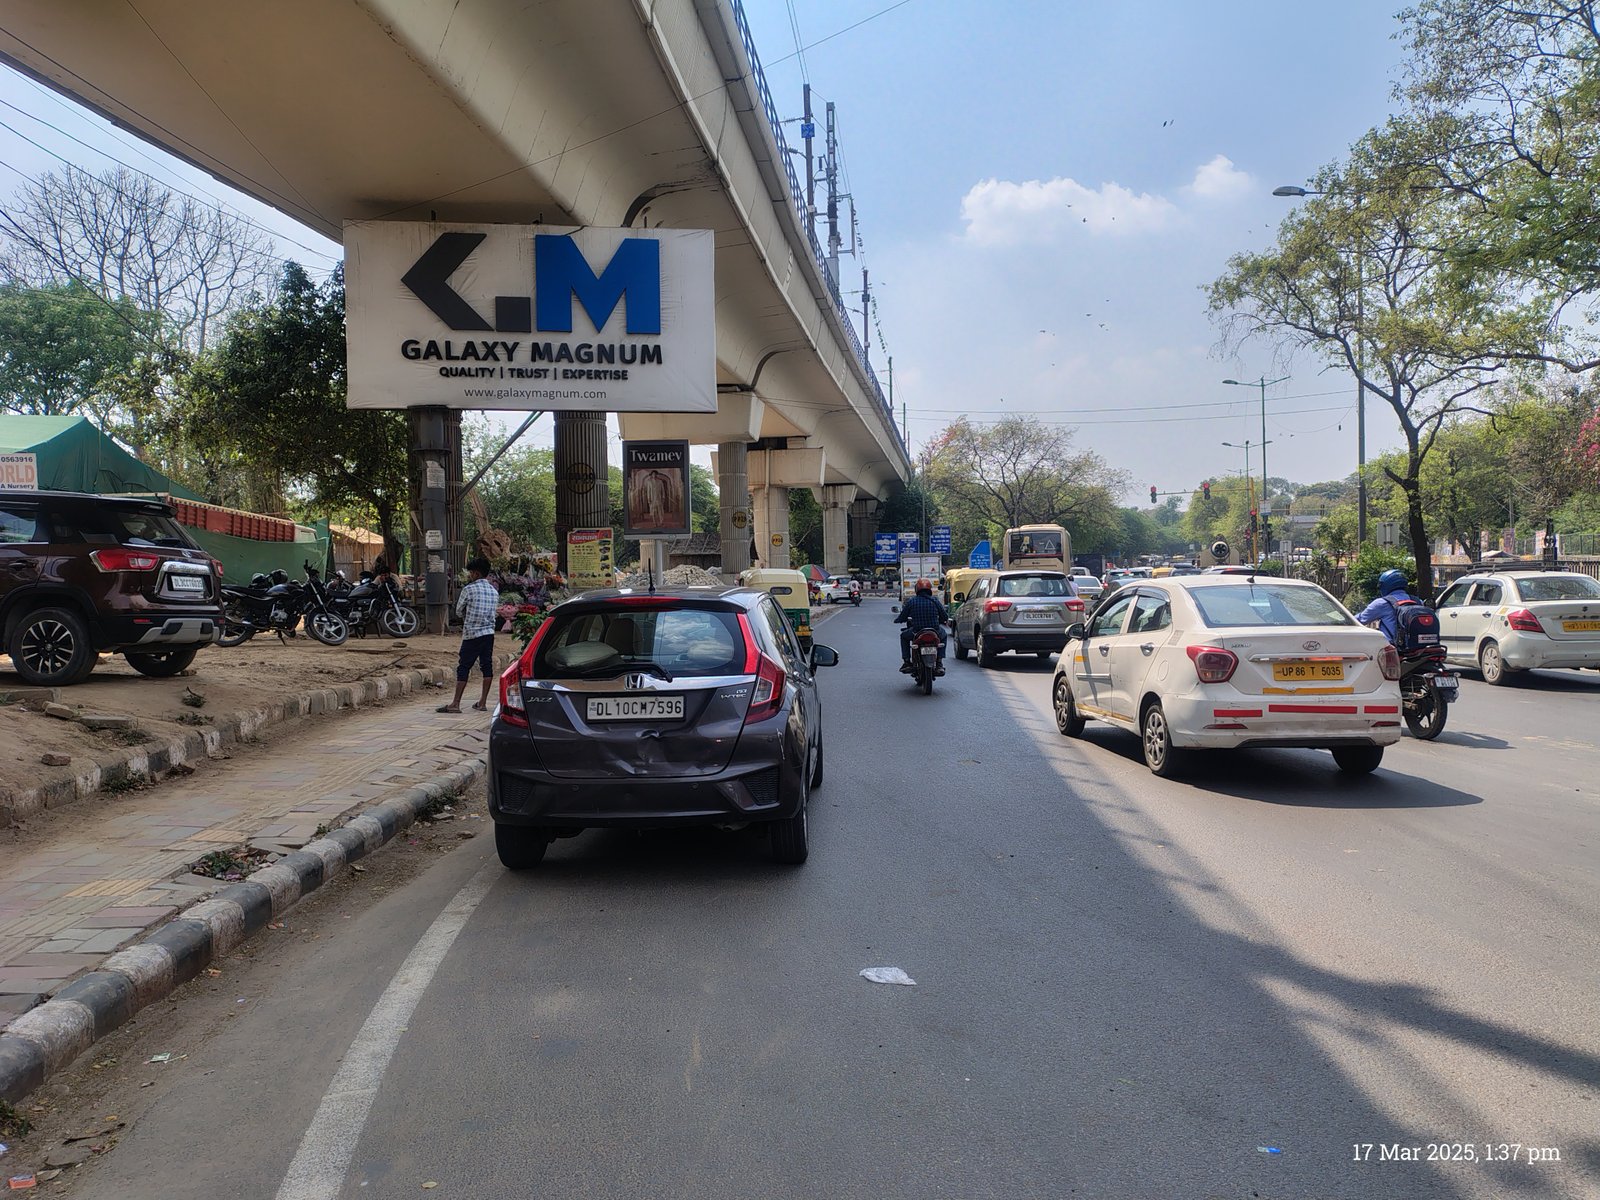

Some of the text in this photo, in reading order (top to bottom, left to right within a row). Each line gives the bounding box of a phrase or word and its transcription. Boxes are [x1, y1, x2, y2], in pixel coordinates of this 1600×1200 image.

[401, 339, 663, 365] GALAXY MAGNUM
[439, 366, 629, 380] QUALITY TRUST EXPERTISE
[464, 387, 607, 400] www.galaxymagnum.com
[630, 449, 683, 462] Twamev
[1282, 666, 1341, 676] UP 86 T 5035
[596, 701, 682, 716] DL10CM7596
